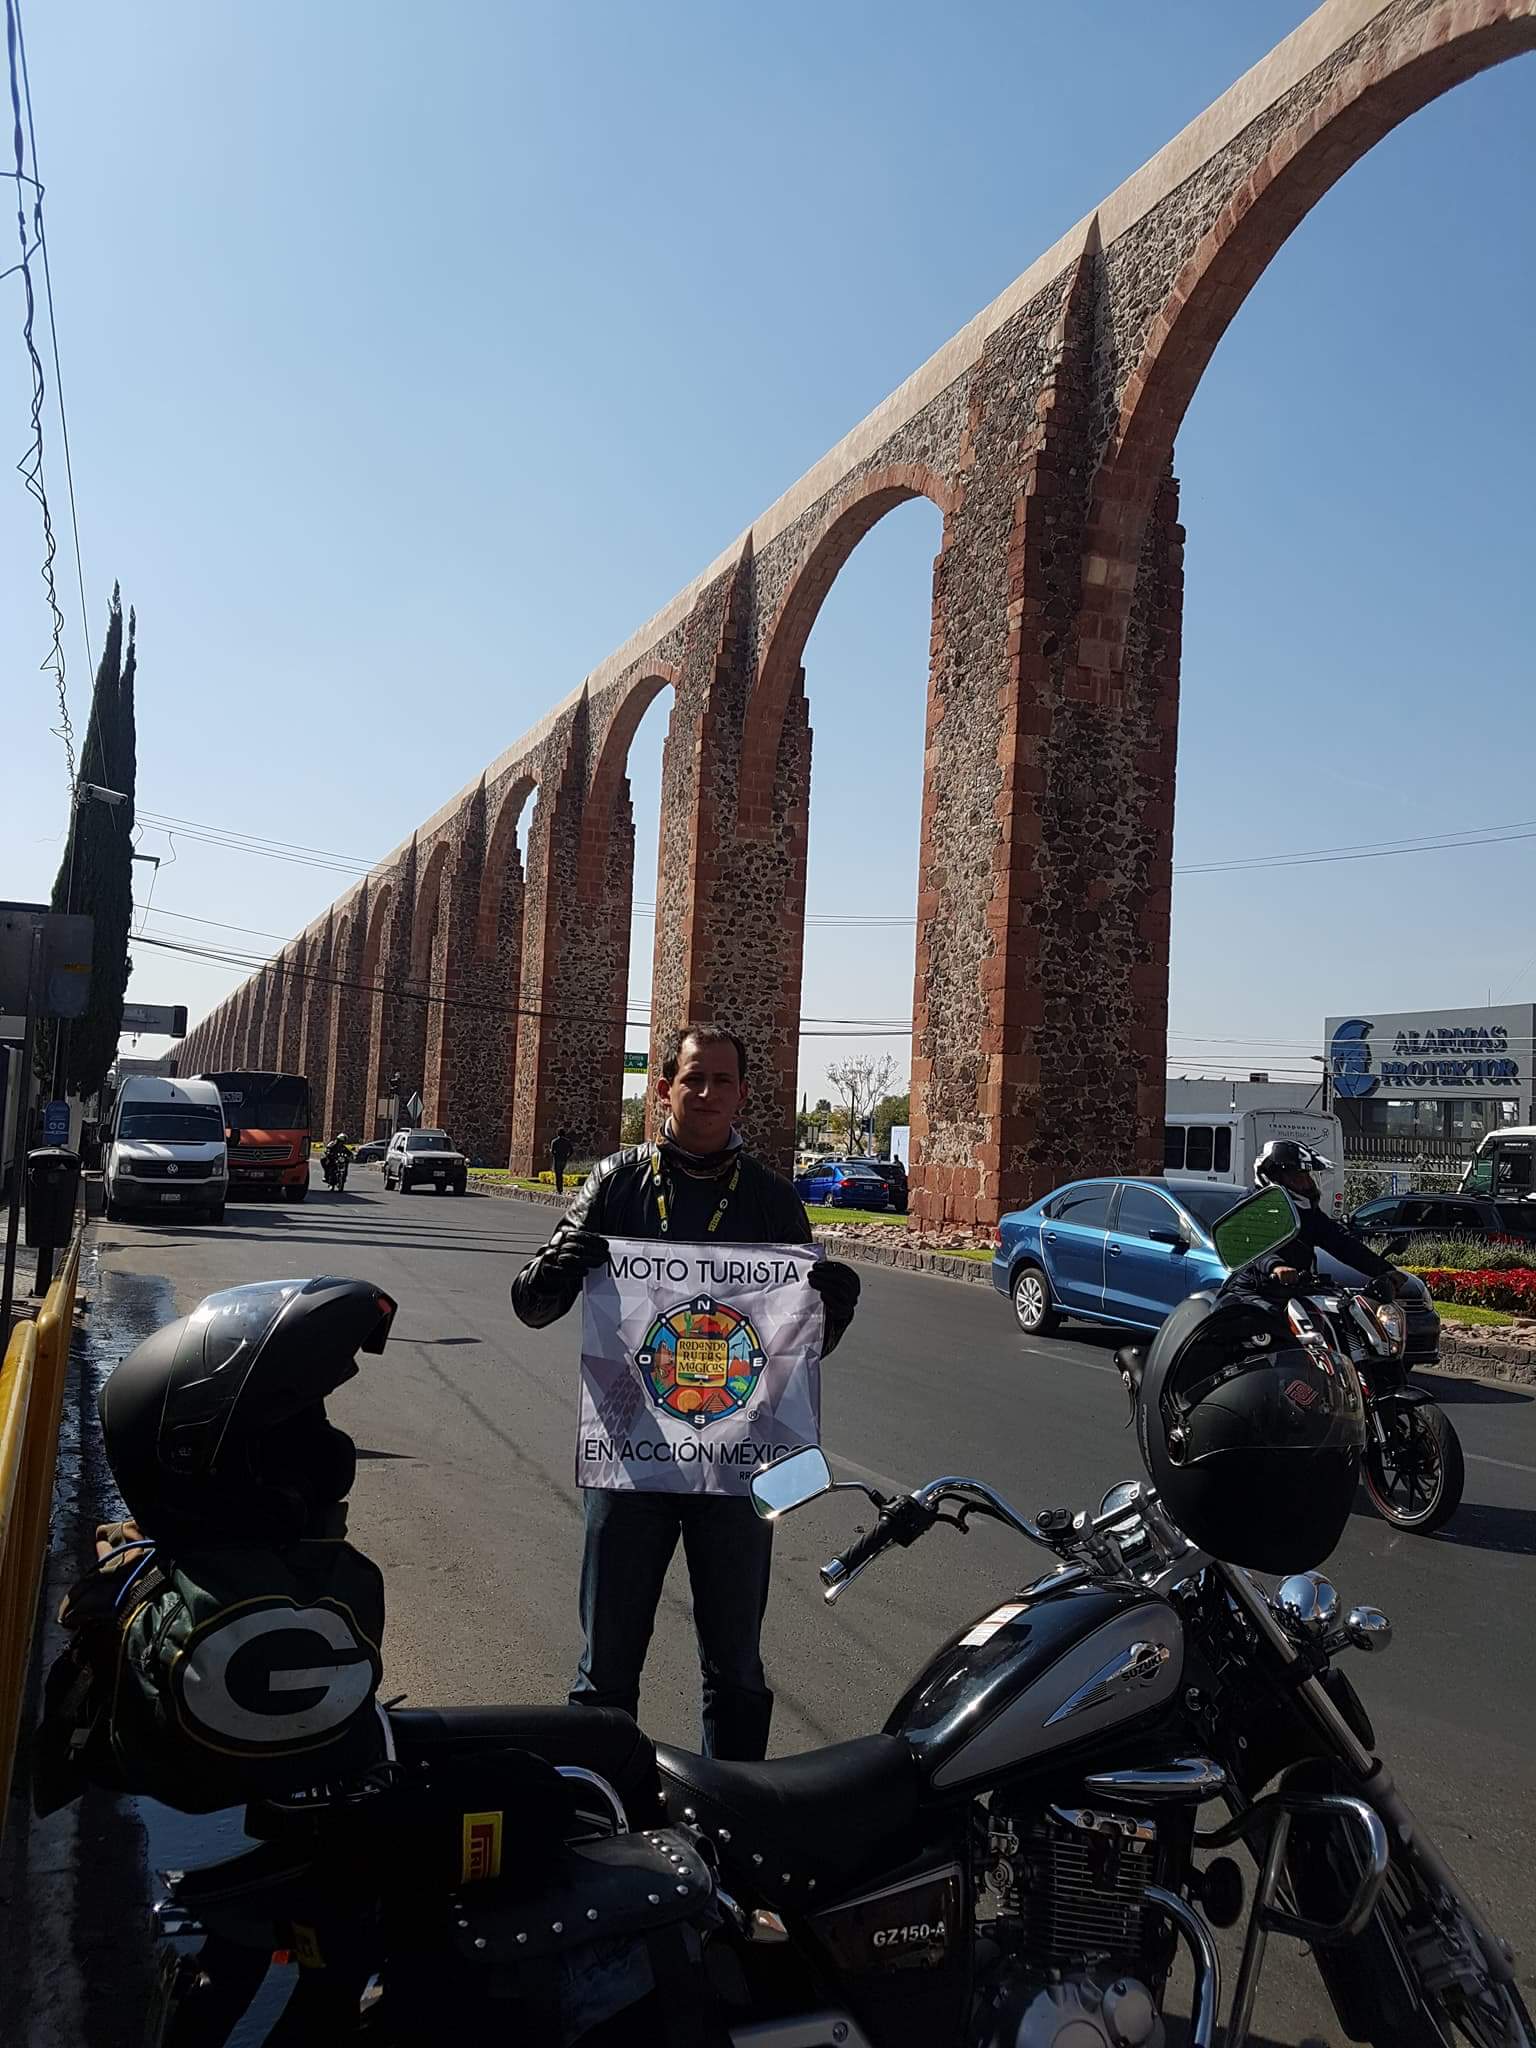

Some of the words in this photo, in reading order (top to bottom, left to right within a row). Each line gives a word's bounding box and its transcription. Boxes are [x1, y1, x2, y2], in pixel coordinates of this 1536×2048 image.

[1392, 1025, 1508, 1055] ALARMAS
[1381, 1058, 1521, 1087] PROTEKTOR
[607, 1256, 688, 1282] MOTO
[695, 1260, 800, 1284] TURISTA
[697, 1300, 710, 1310] N
[753, 1357, 763, 1367] E
[693, 1414, 705, 1424] S
[584, 1439, 614, 1462] EN
[619, 1436, 713, 1464] ACCIÓN
[720, 1438, 802, 1465] MÉXIC
[183, 1607, 374, 1741] G
[1120, 1654, 1162, 1681] SUZUKI
[872, 1920, 945, 1947] GZ150-A
